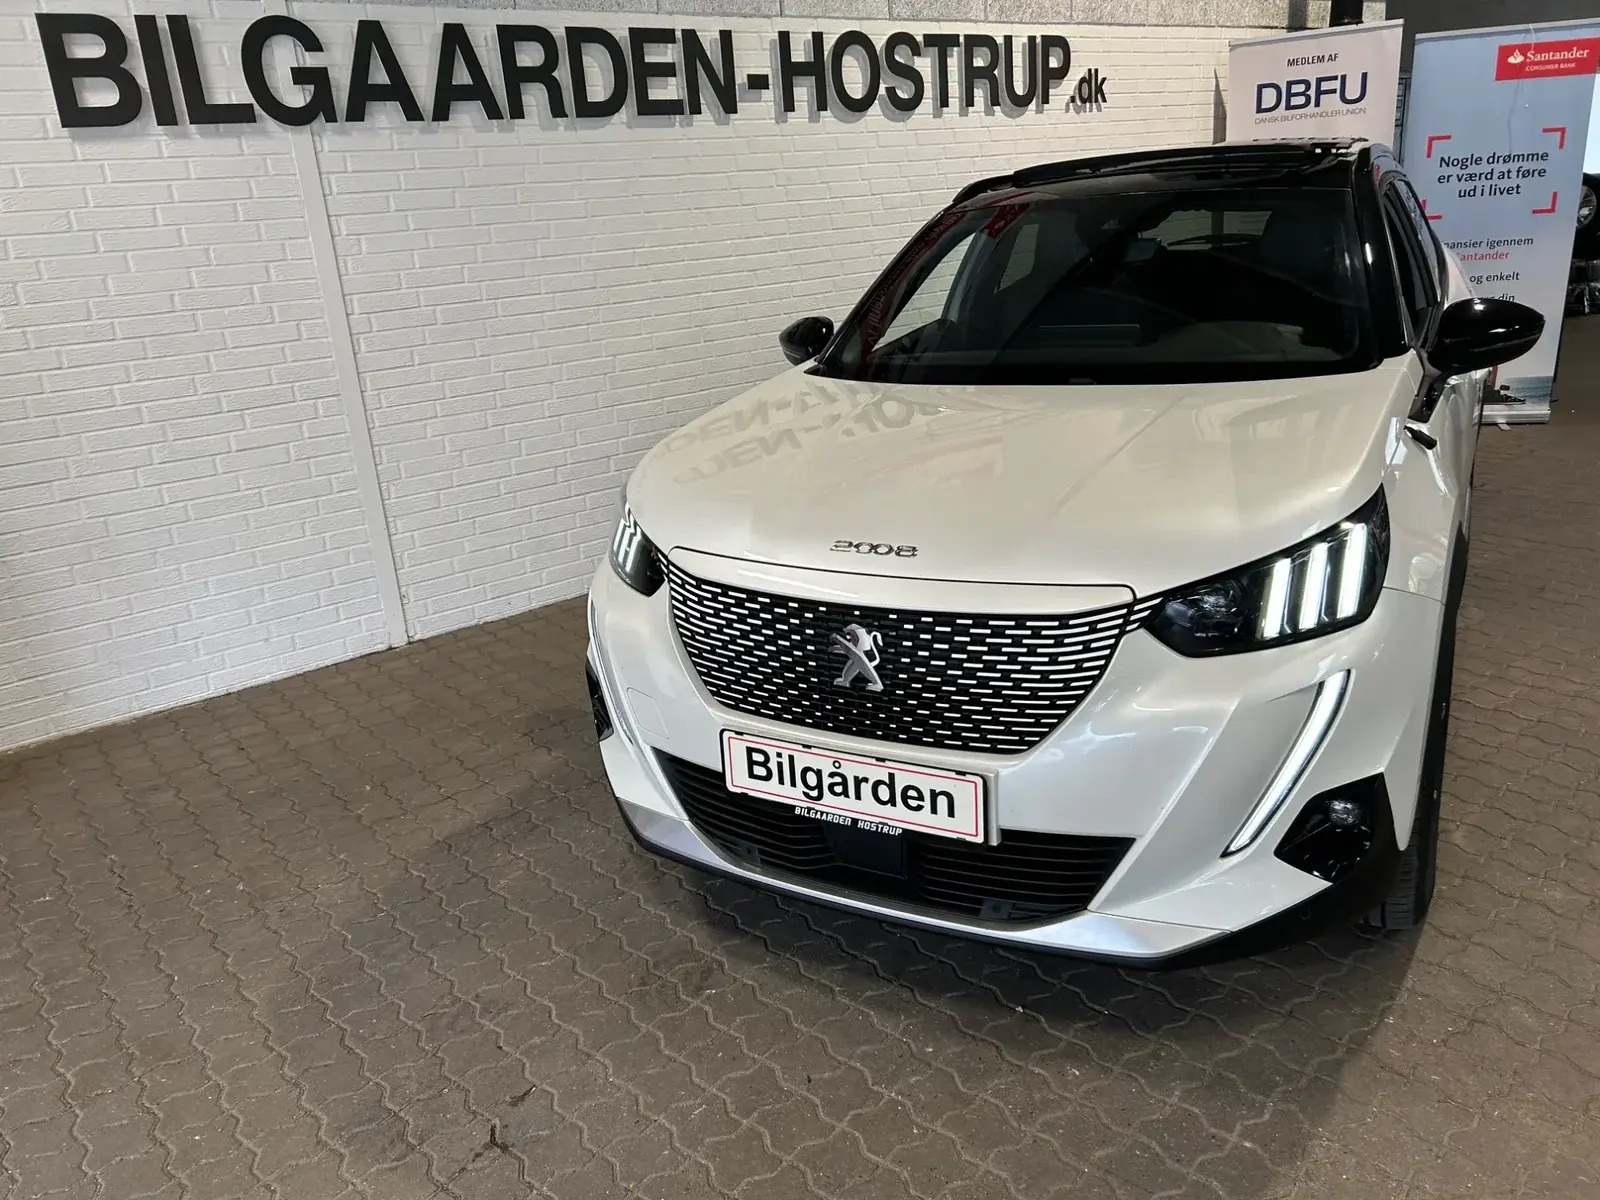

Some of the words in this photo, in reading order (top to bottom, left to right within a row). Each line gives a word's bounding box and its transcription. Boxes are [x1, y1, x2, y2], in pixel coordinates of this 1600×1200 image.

[1287, 55, 1325, 67] MEDLEM
[1327, 53, 1339, 63] AF
[1526, 47, 1589, 62] Santander
[1256, 72, 1368, 114] DBFU
[1255, 116, 1280, 125] DANSK
[1280, 110, 1341, 122] BILFORHANDLER
[1341, 107, 1367, 116] UNION
[1439, 153, 1483, 170] Nogle
[1486, 152, 1549, 165] drømme
[1437, 174, 1453, 184] er
[1456, 168, 1494, 183] værd
[1497, 169, 1512, 180] at
[1516, 166, 1547, 179] føre
[1458, 185, 1477, 198] ud
[1480, 185, 1485, 197] i
[1489, 183, 1521, 196] livet
[1486, 238, 1534, 249] igennem
[1456, 251, 1510, 261] antander
[1469, 275, 1483, 284] og
[1486, 271, 1520, 281] enkelt
[830, 540, 918, 557] 2008
[745, 746, 956, 819] Bilgården
[794, 806, 852, 826] BILGAARDEN
[857, 819, 903, 836] HOSTRUP
